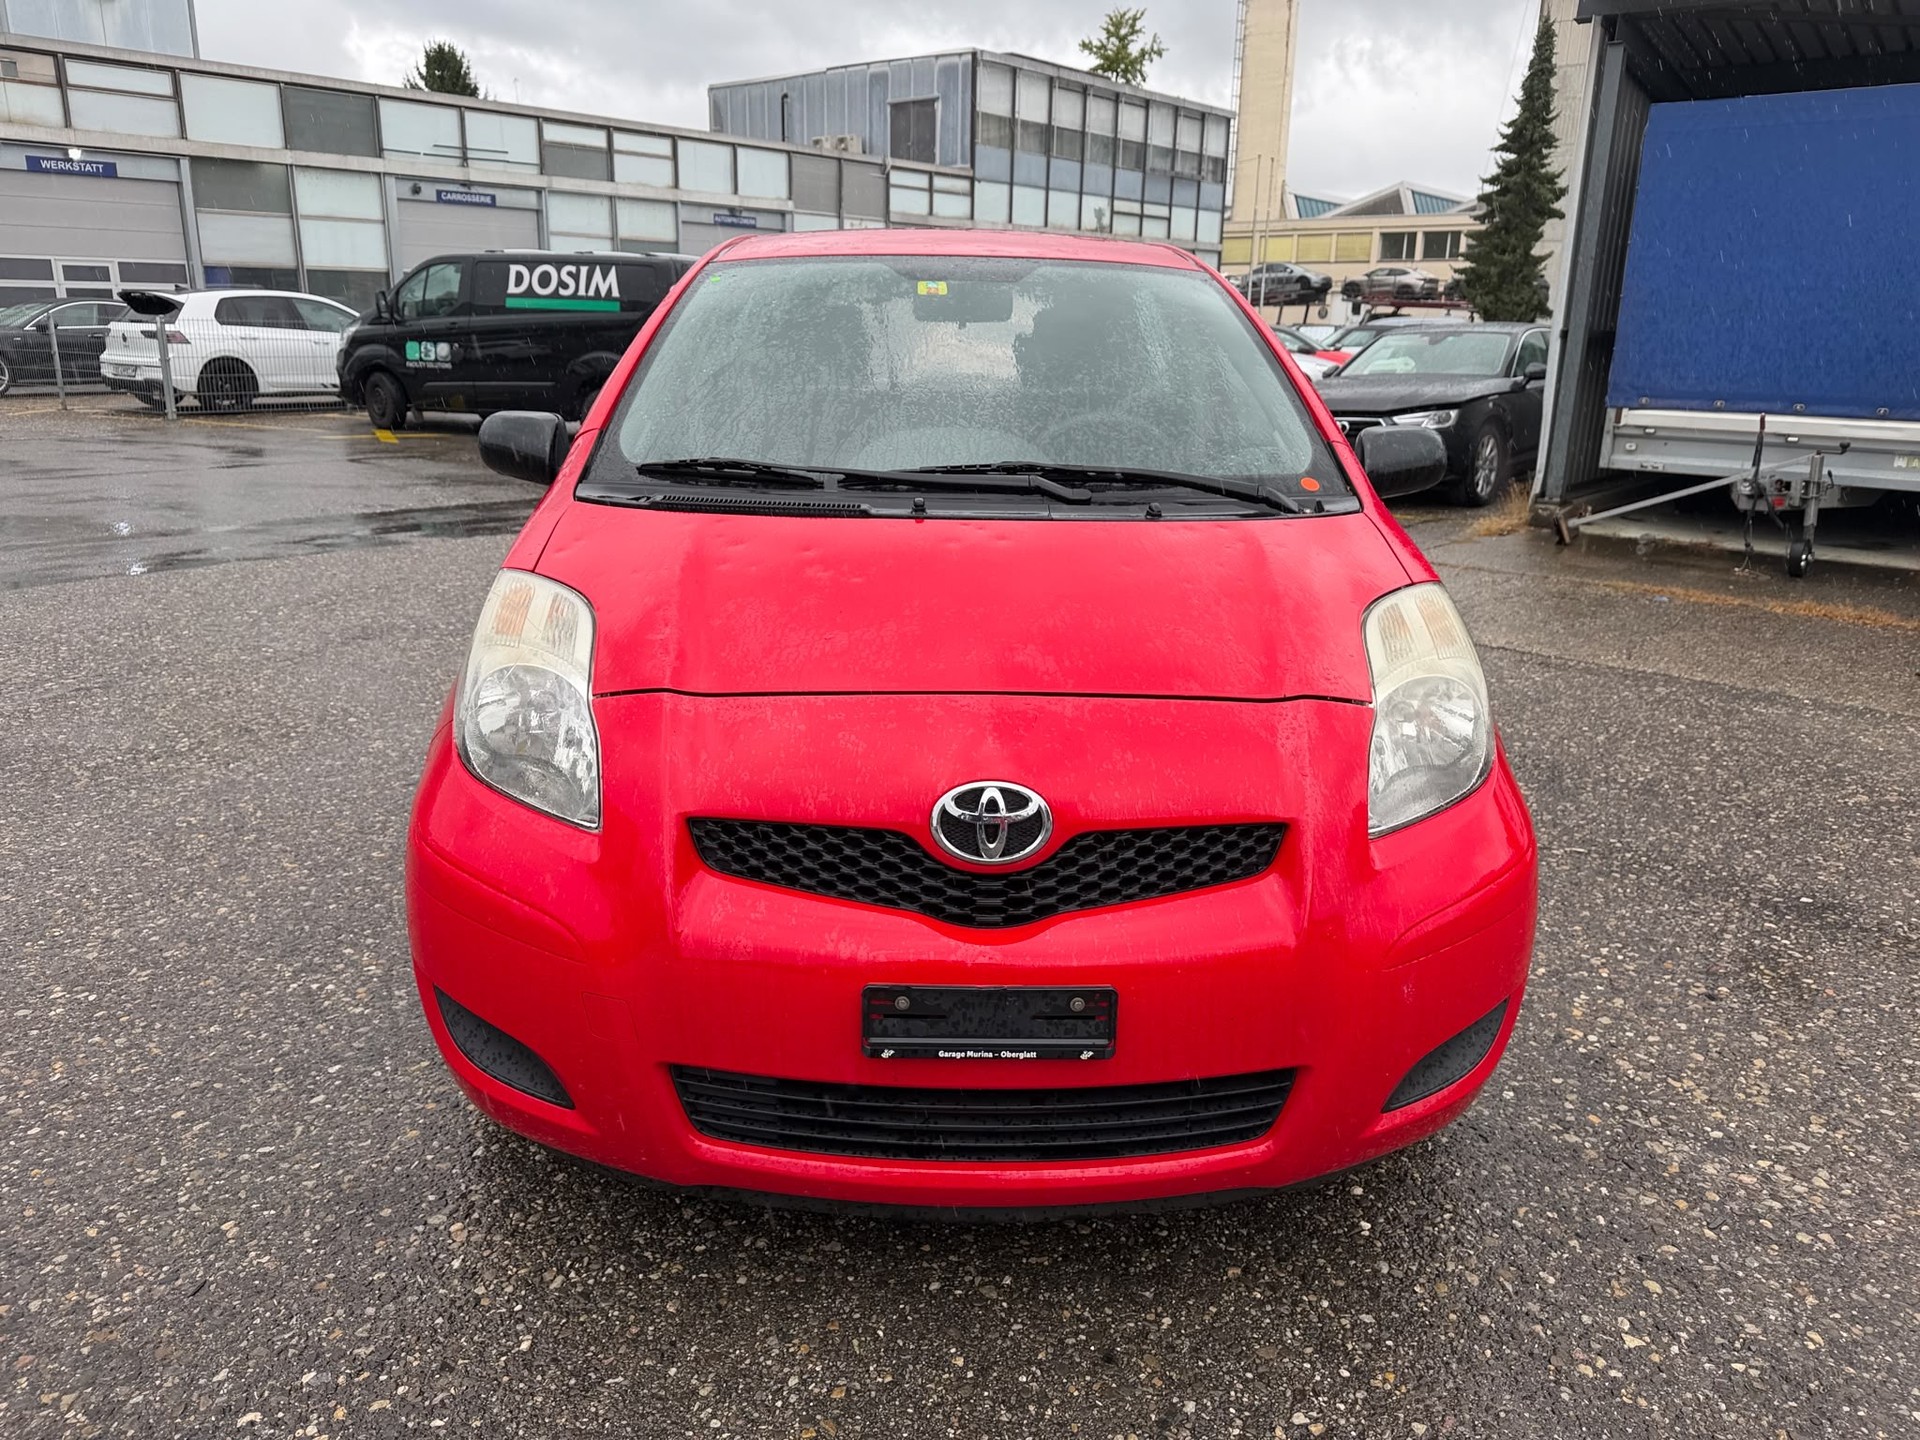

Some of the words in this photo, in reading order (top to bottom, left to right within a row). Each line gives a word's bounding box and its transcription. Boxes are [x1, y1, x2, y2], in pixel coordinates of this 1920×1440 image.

[40, 159, 104, 173] WERKSTATT
[440, 191, 492, 204] CARROSSERIE
[506, 263, 621, 298] DOSIM
[938, 1050, 966, 1059] Garage
[966, 1050, 993, 1058] Murina
[1000, 1051, 1037, 1060] Oberglatt
